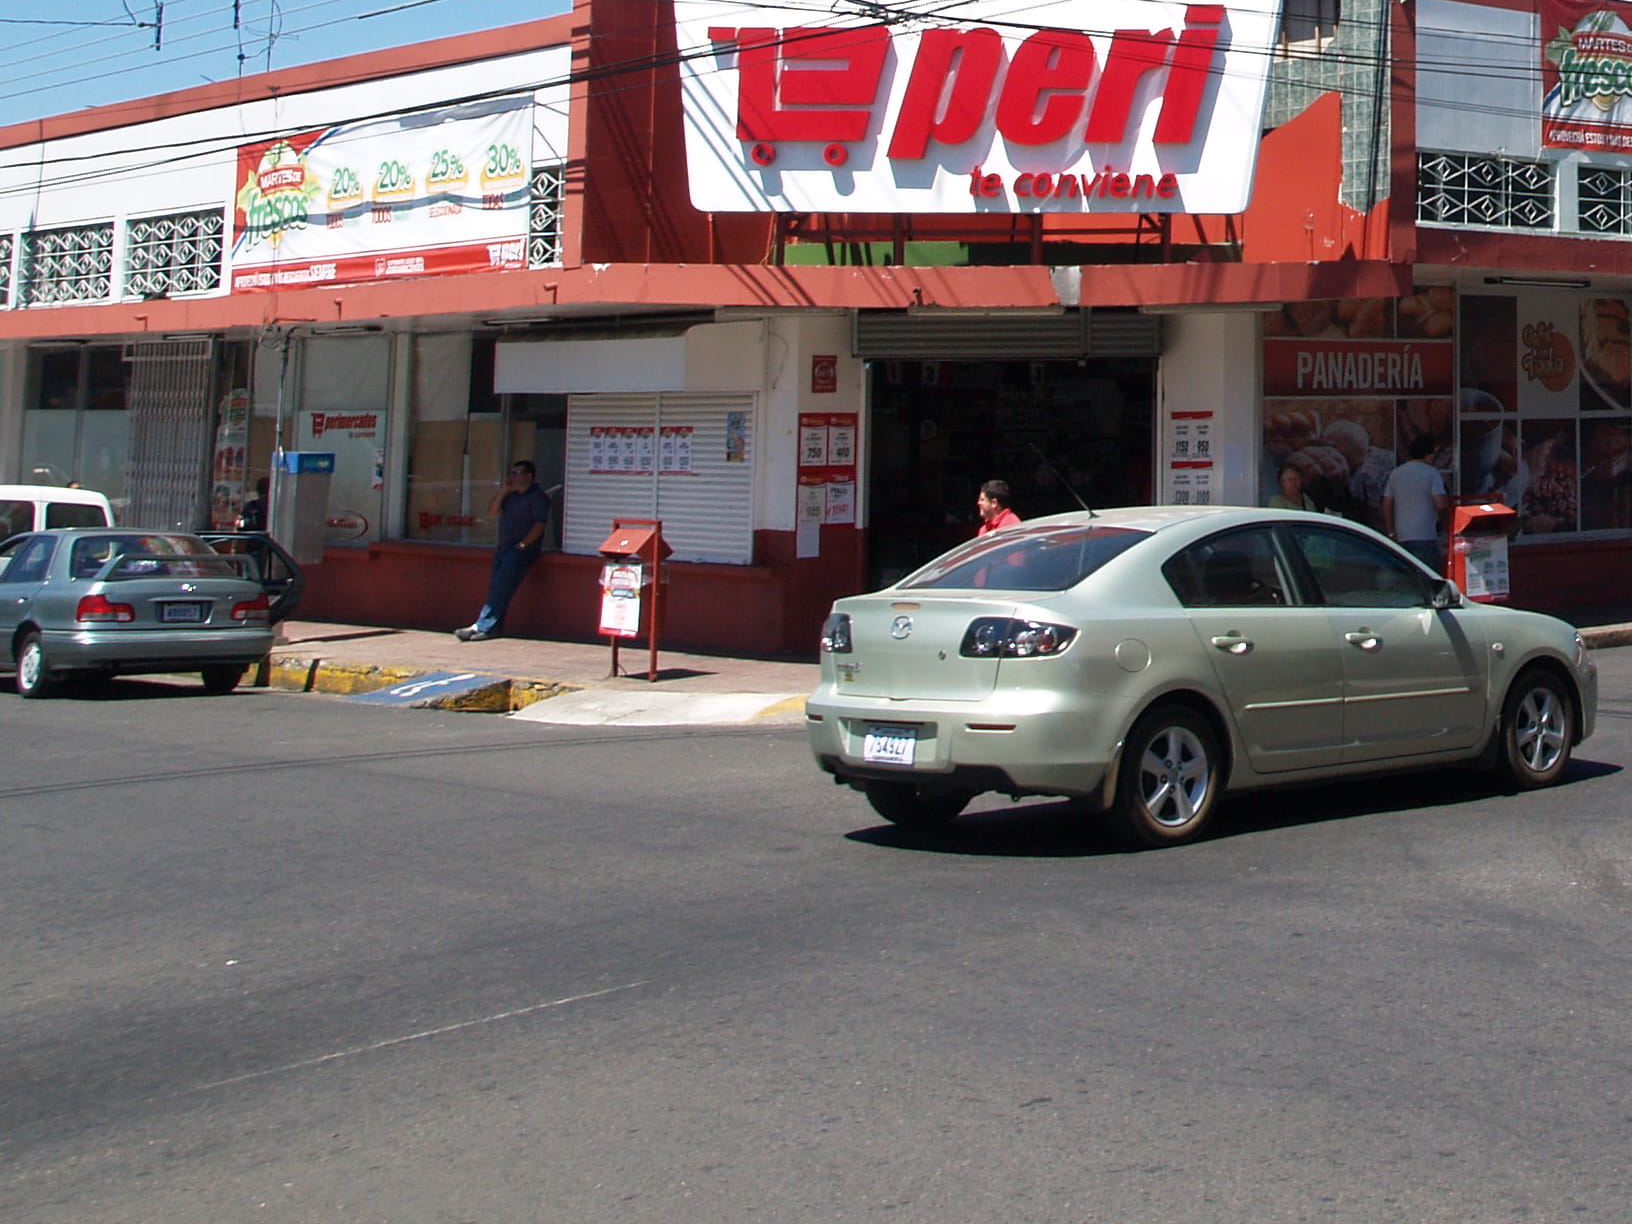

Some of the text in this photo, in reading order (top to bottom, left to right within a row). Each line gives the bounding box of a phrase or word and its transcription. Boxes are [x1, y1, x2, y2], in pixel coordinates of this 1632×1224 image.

[886, 4, 1225, 160] peri
[968, 164, 1178, 200] te conviene
[1296, 343, 1425, 390] PANADERÍA
